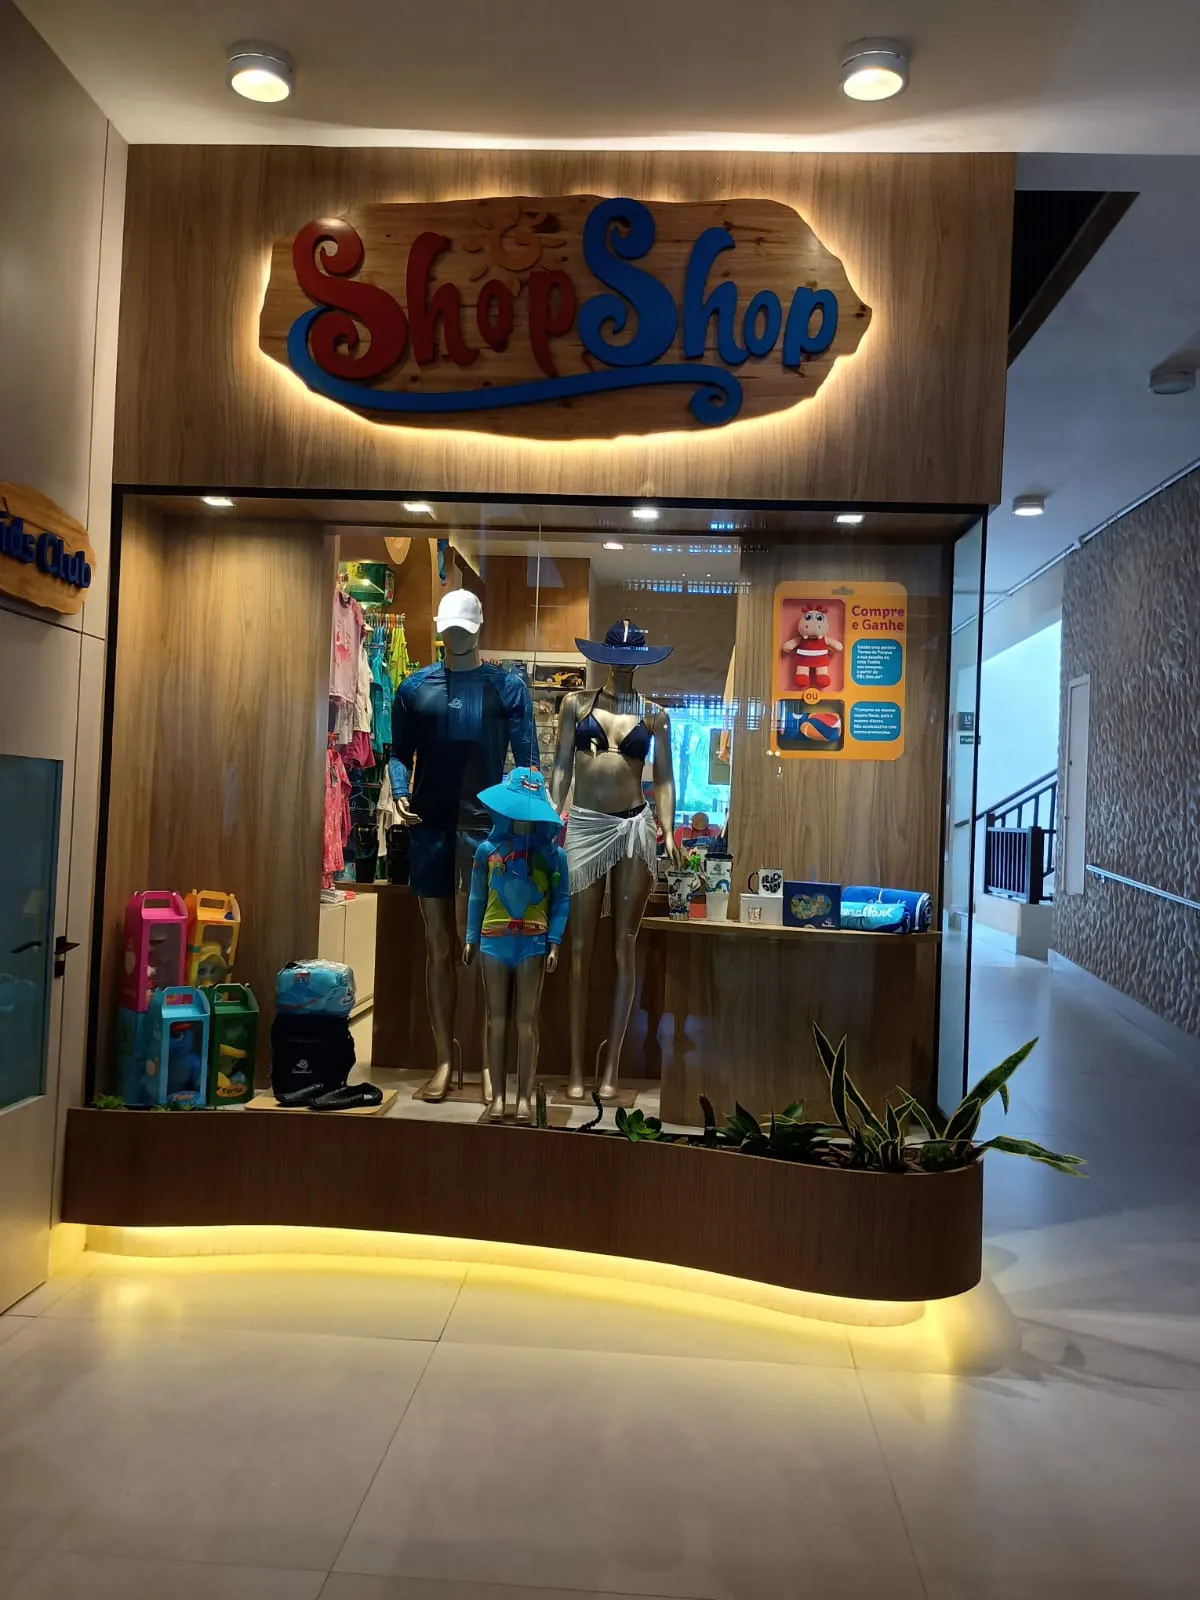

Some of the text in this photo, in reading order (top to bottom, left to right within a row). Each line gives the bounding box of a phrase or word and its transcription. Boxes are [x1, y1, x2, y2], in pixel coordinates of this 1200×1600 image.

[292, 197, 838, 379] Shop Shop
[0, 510, 92, 589] ids Club
[851, 605, 905, 619] Compre
[851, 619, 905, 631] e Ganhe
